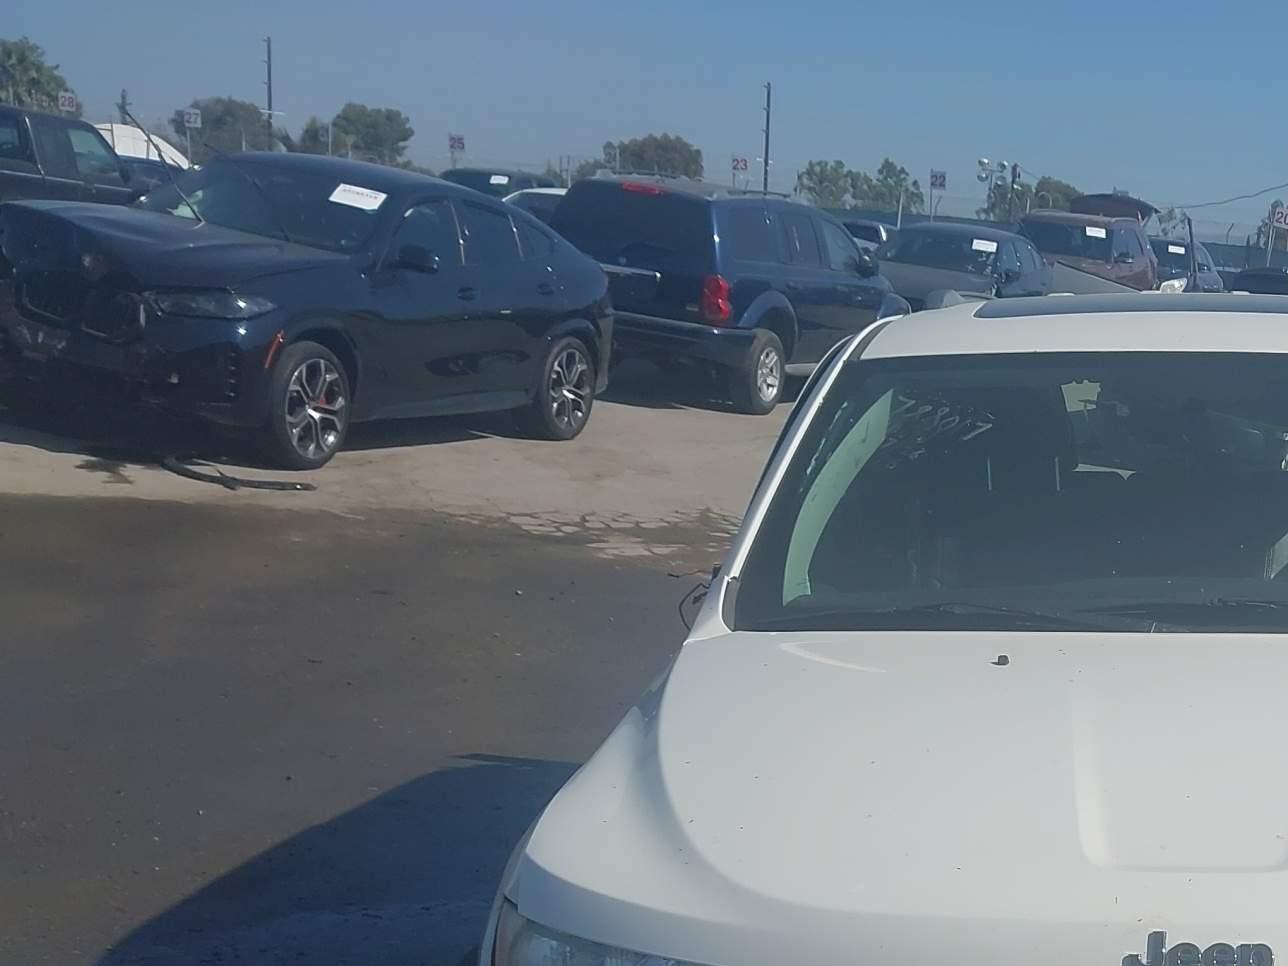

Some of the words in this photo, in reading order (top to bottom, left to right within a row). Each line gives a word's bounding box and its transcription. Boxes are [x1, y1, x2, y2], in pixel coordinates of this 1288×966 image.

[60, 95, 75, 109] 28
[185, 111, 200, 124] 27
[448, 136, 465, 150] 25
[732, 158, 748, 170] 23
[930, 174, 946, 187] 22
